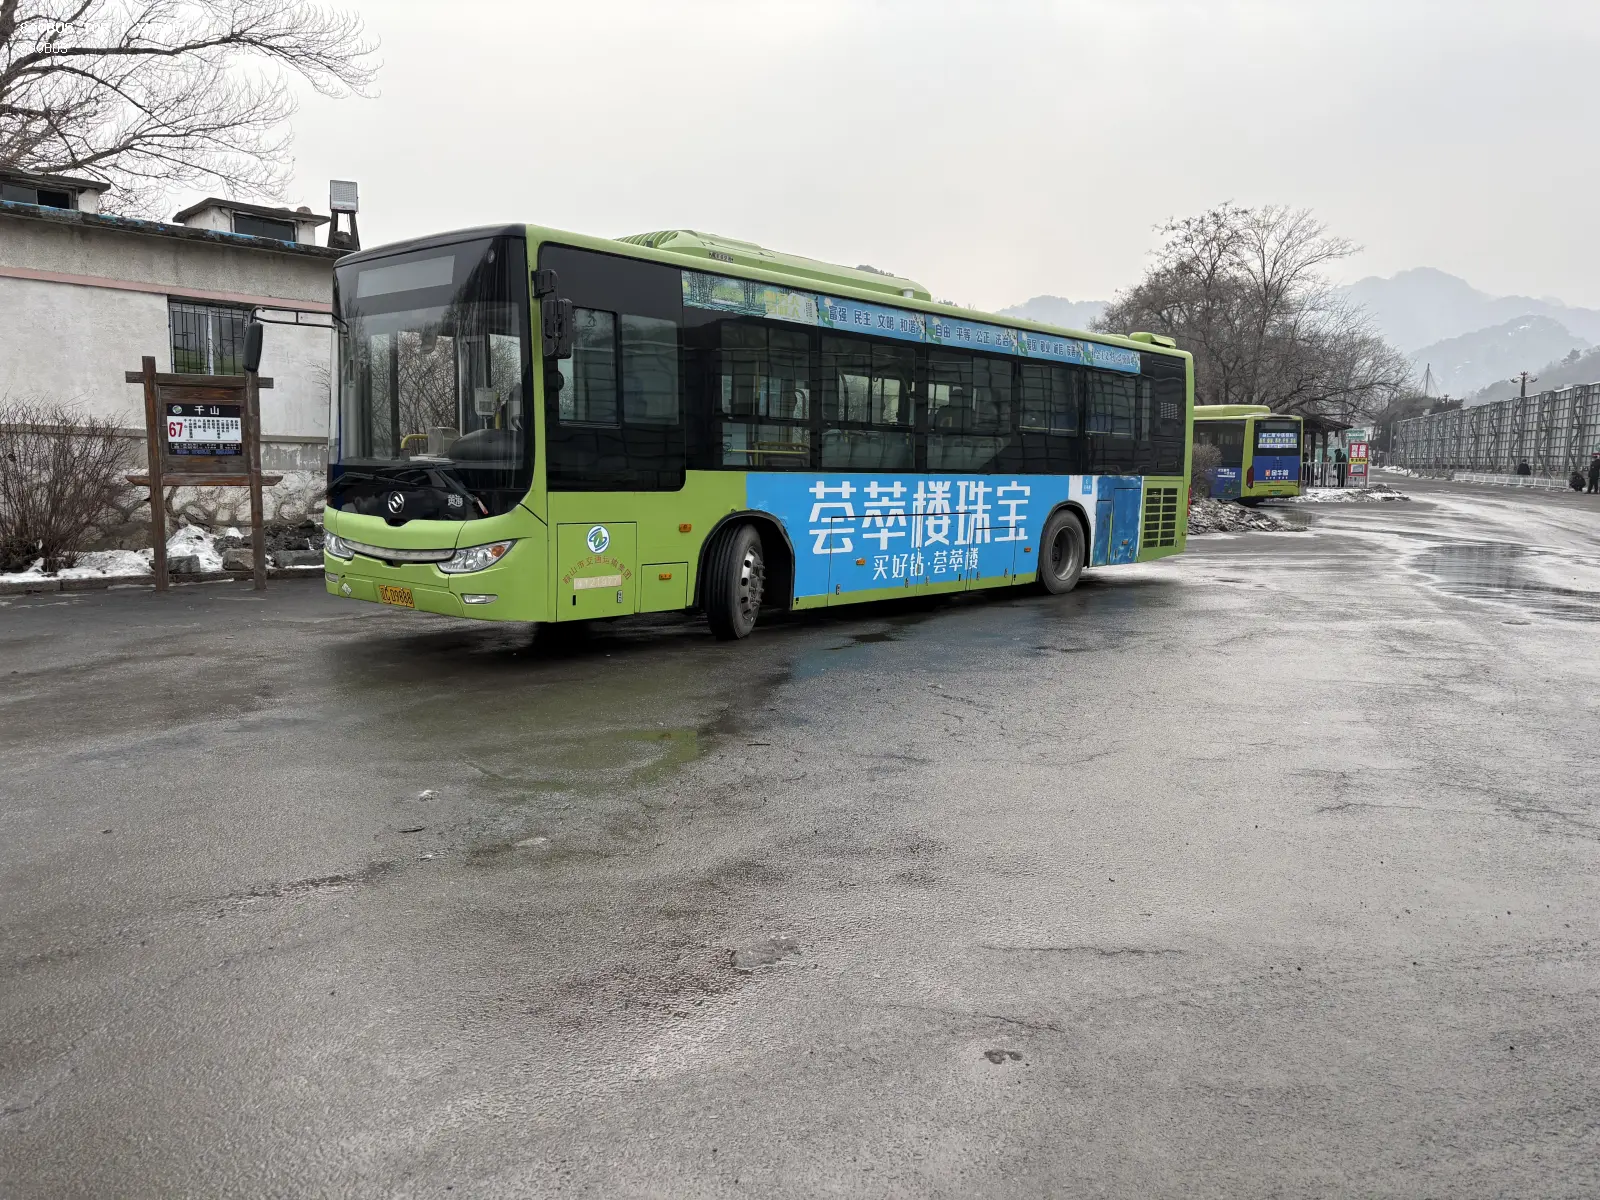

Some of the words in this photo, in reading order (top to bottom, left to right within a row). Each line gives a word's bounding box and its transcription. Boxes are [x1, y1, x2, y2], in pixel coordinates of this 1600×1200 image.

[828, 305, 848, 323] 富强
[854, 309, 872, 326] 民主
[877, 314, 894, 331] 文明
[900, 318, 916, 334] 和谐
[935, 323, 951, 339] 自由
[956, 327, 971, 341] 平等
[975, 330, 990, 344] 公正
[193, 405, 220, 416] 千山
[168, 421, 184, 438] 67
[808, 480, 1031, 555] 荟萃楼珠宝
